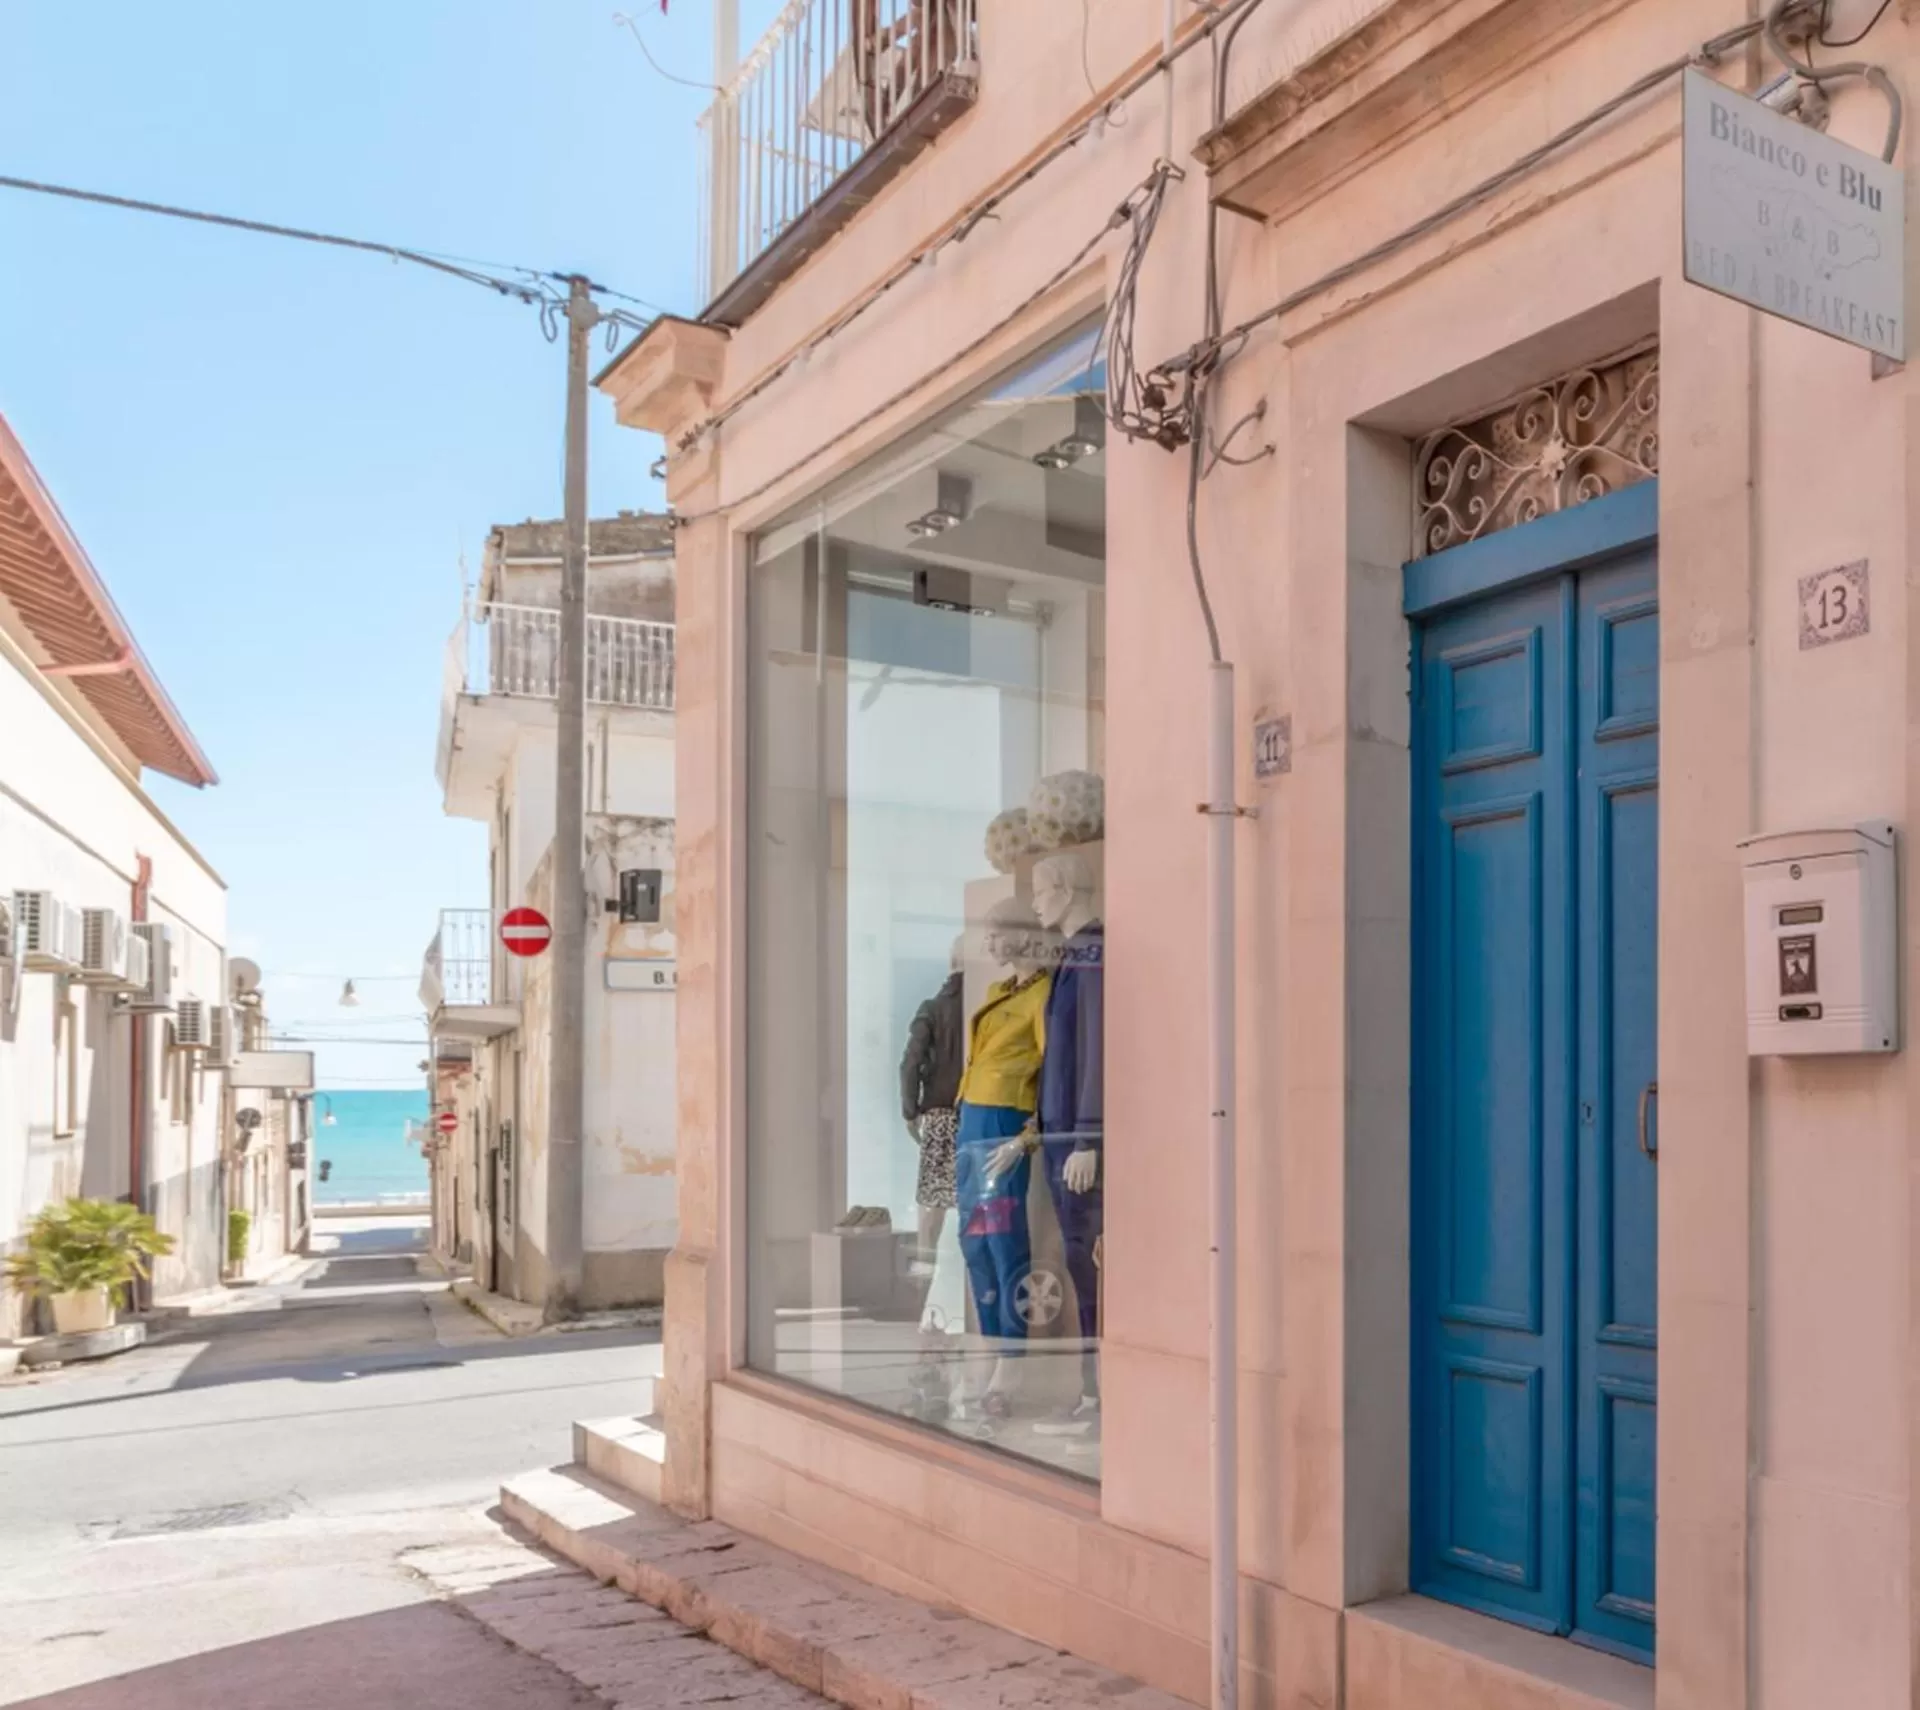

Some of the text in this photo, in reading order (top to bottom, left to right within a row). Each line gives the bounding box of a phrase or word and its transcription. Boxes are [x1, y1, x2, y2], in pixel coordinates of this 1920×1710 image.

[1708, 100, 1882, 213] Bianco e Blu
[1757, 200, 1839, 256] B & B
[1774, 272, 1897, 349] BREAKFAST
[1818, 585, 1847, 629] 13
[1265, 733, 1278, 761] 11
